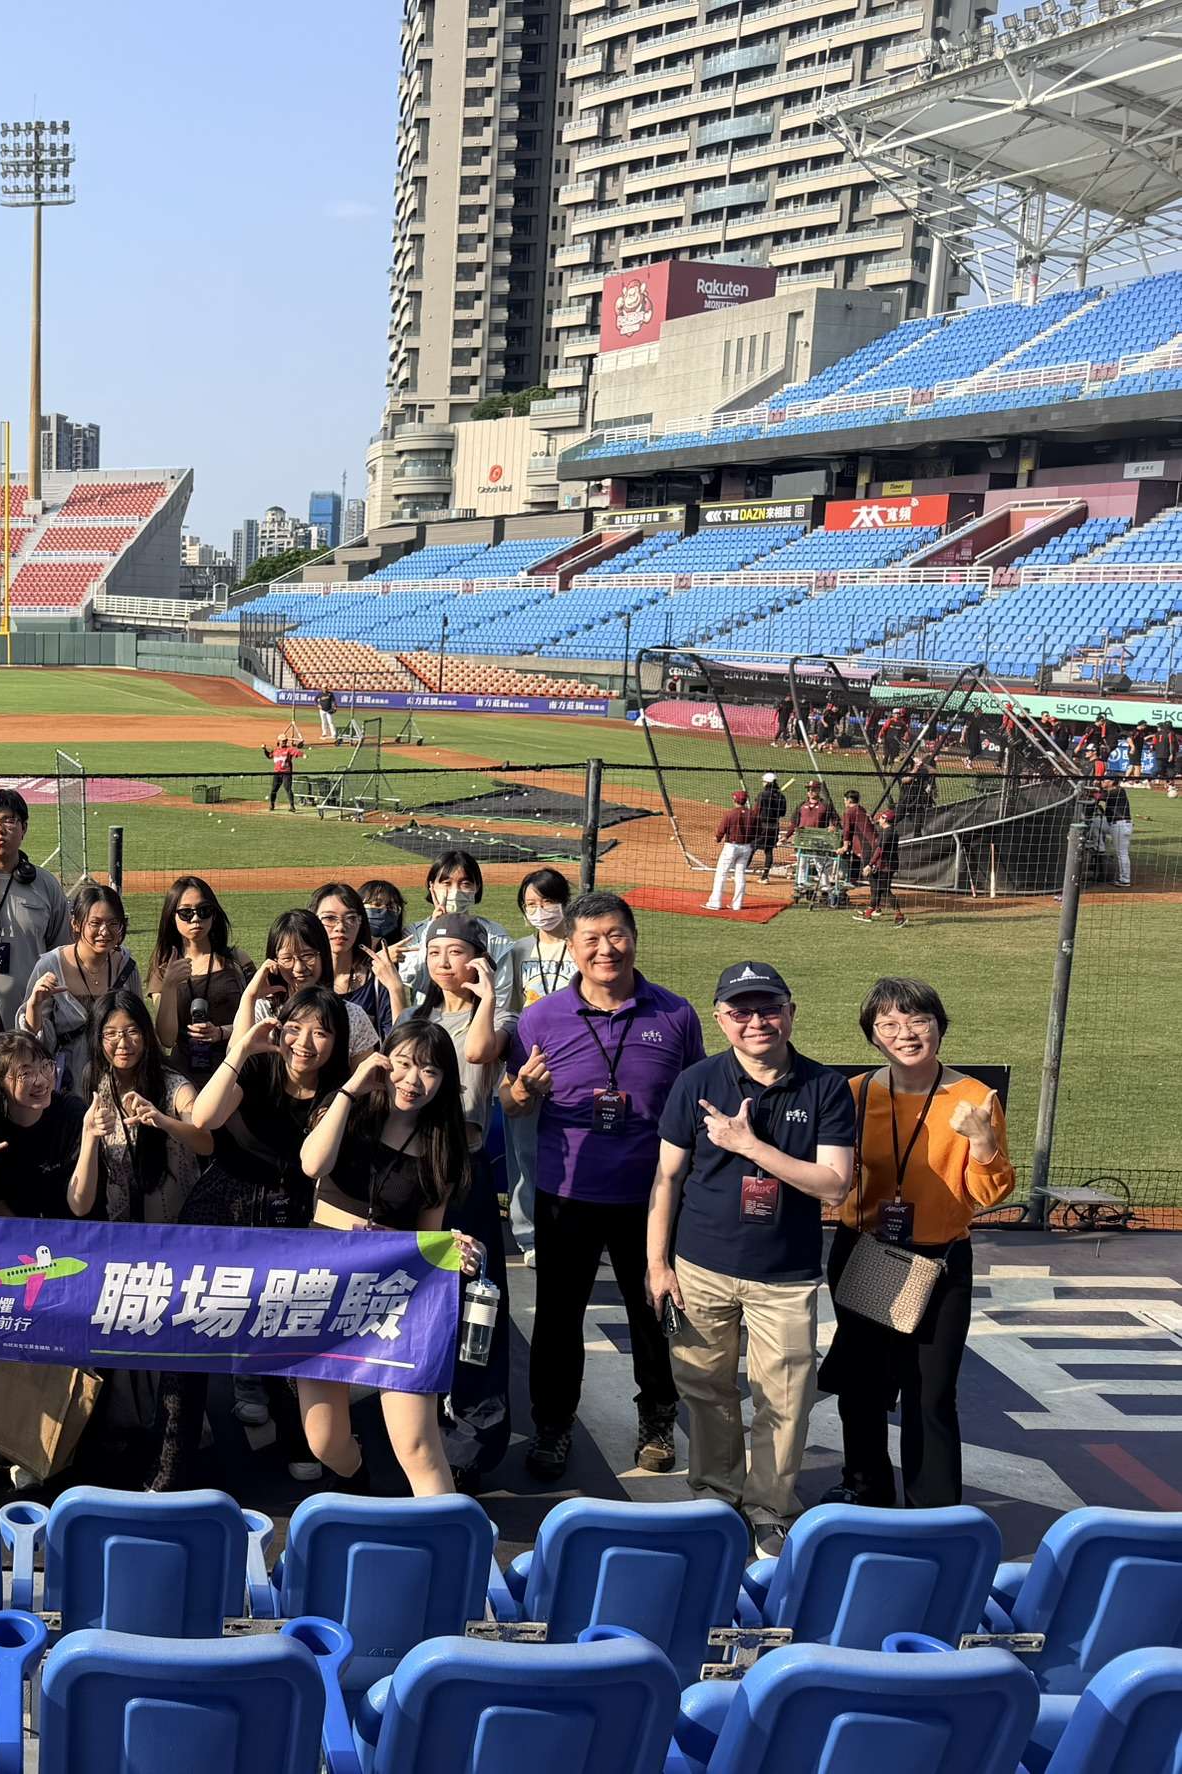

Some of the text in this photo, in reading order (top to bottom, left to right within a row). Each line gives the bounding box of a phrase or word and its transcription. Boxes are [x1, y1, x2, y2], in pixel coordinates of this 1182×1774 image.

[696, 278, 749, 299] Rakuten
[1055, 703, 1114, 717] SKODA
[90, 1261, 419, 1341] 職場體驗
